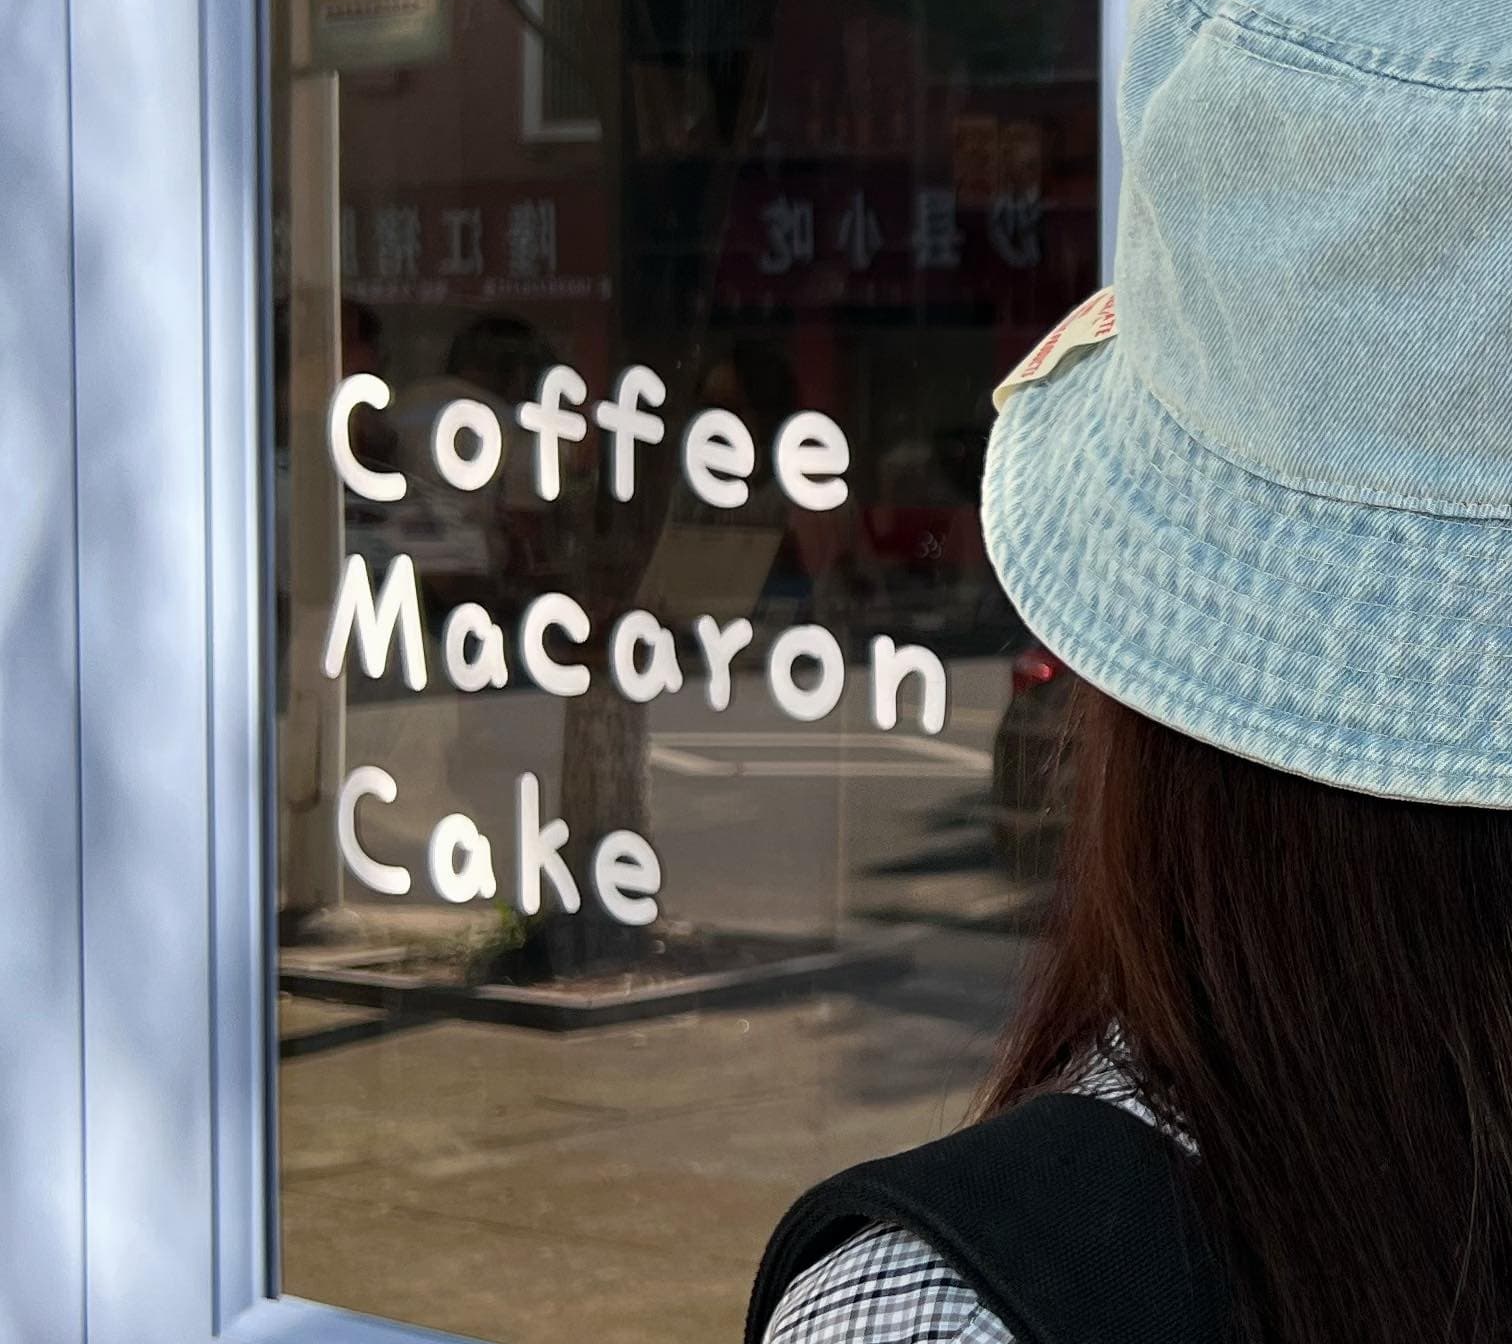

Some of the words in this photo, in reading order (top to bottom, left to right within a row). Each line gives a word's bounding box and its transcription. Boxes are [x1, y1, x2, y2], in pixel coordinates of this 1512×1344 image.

[329, 364, 851, 511] Coffee
[324, 552, 947, 734] Macaron
[336, 765, 662, 925] Cake
